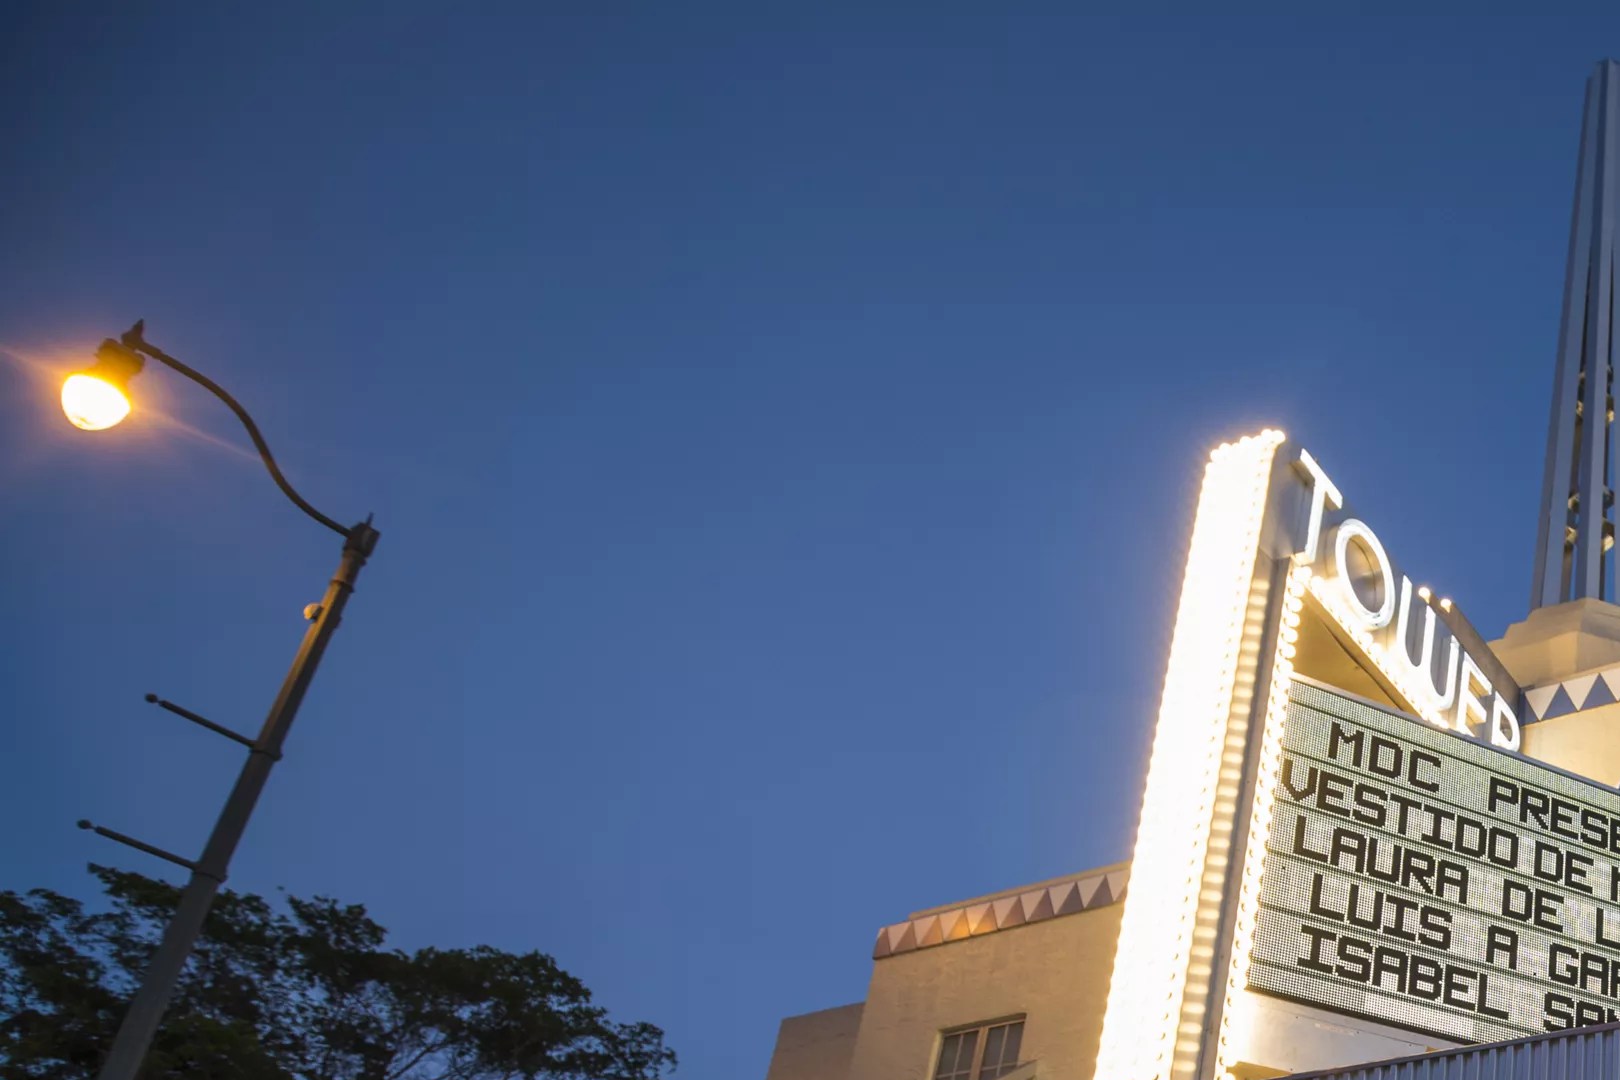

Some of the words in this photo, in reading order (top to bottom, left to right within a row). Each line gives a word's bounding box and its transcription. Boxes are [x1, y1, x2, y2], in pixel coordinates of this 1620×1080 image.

[1328, 720, 1442, 793] MDC
[1281, 757, 1519, 870] VESTIDO
[1534, 840, 1594, 895] DE
[1294, 814, 1469, 904] LAURA
[1501, 883, 1564, 933] DE
[1310, 872, 1453, 952] LUIS
[1486, 927, 1519, 971] A
[1297, 924, 1510, 1021] ISABEL
